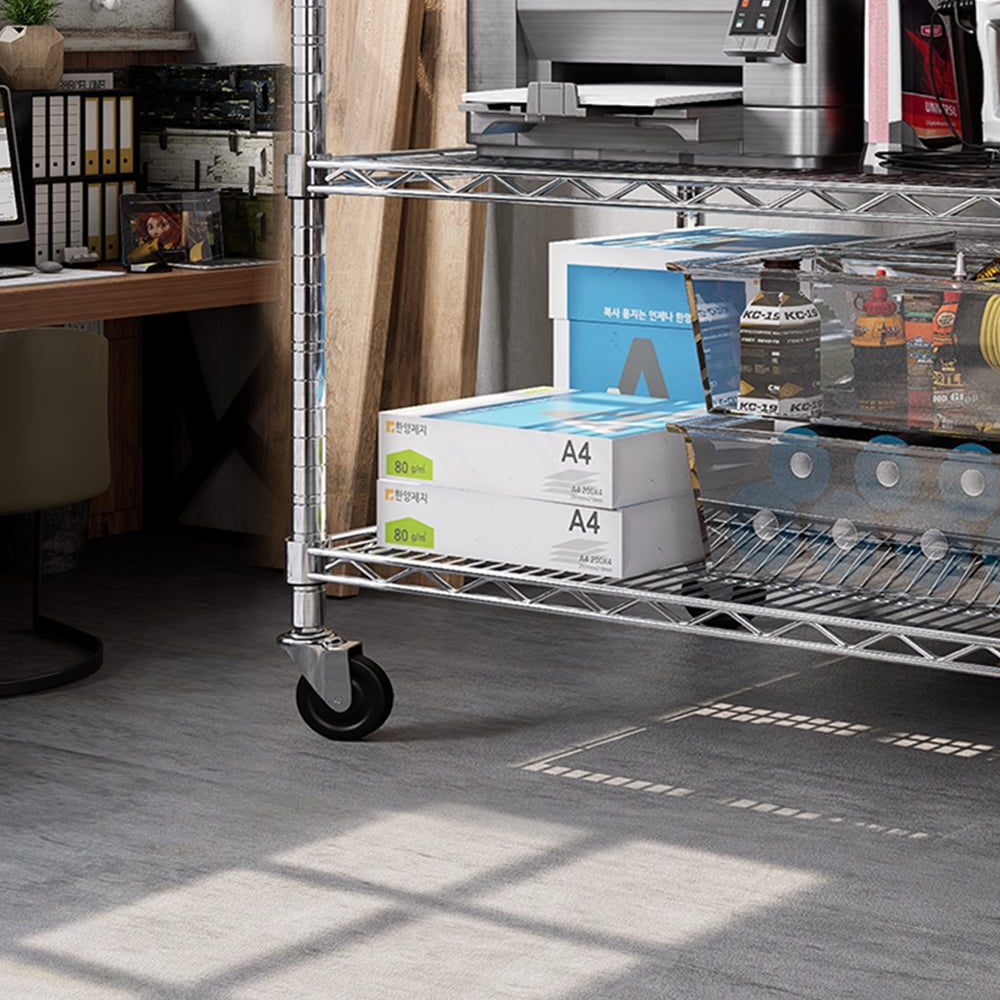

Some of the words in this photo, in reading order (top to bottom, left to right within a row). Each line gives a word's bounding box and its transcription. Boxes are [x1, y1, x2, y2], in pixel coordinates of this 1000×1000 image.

[740, 402, 778, 413] KC-19
[395, 421, 428, 436] 한양제지
[561, 439, 592, 465] A4
[394, 460, 409, 474] 80
[395, 489, 428, 504] 한양제지
[569, 508, 601, 535] A4
[393, 528, 409, 542] 80
